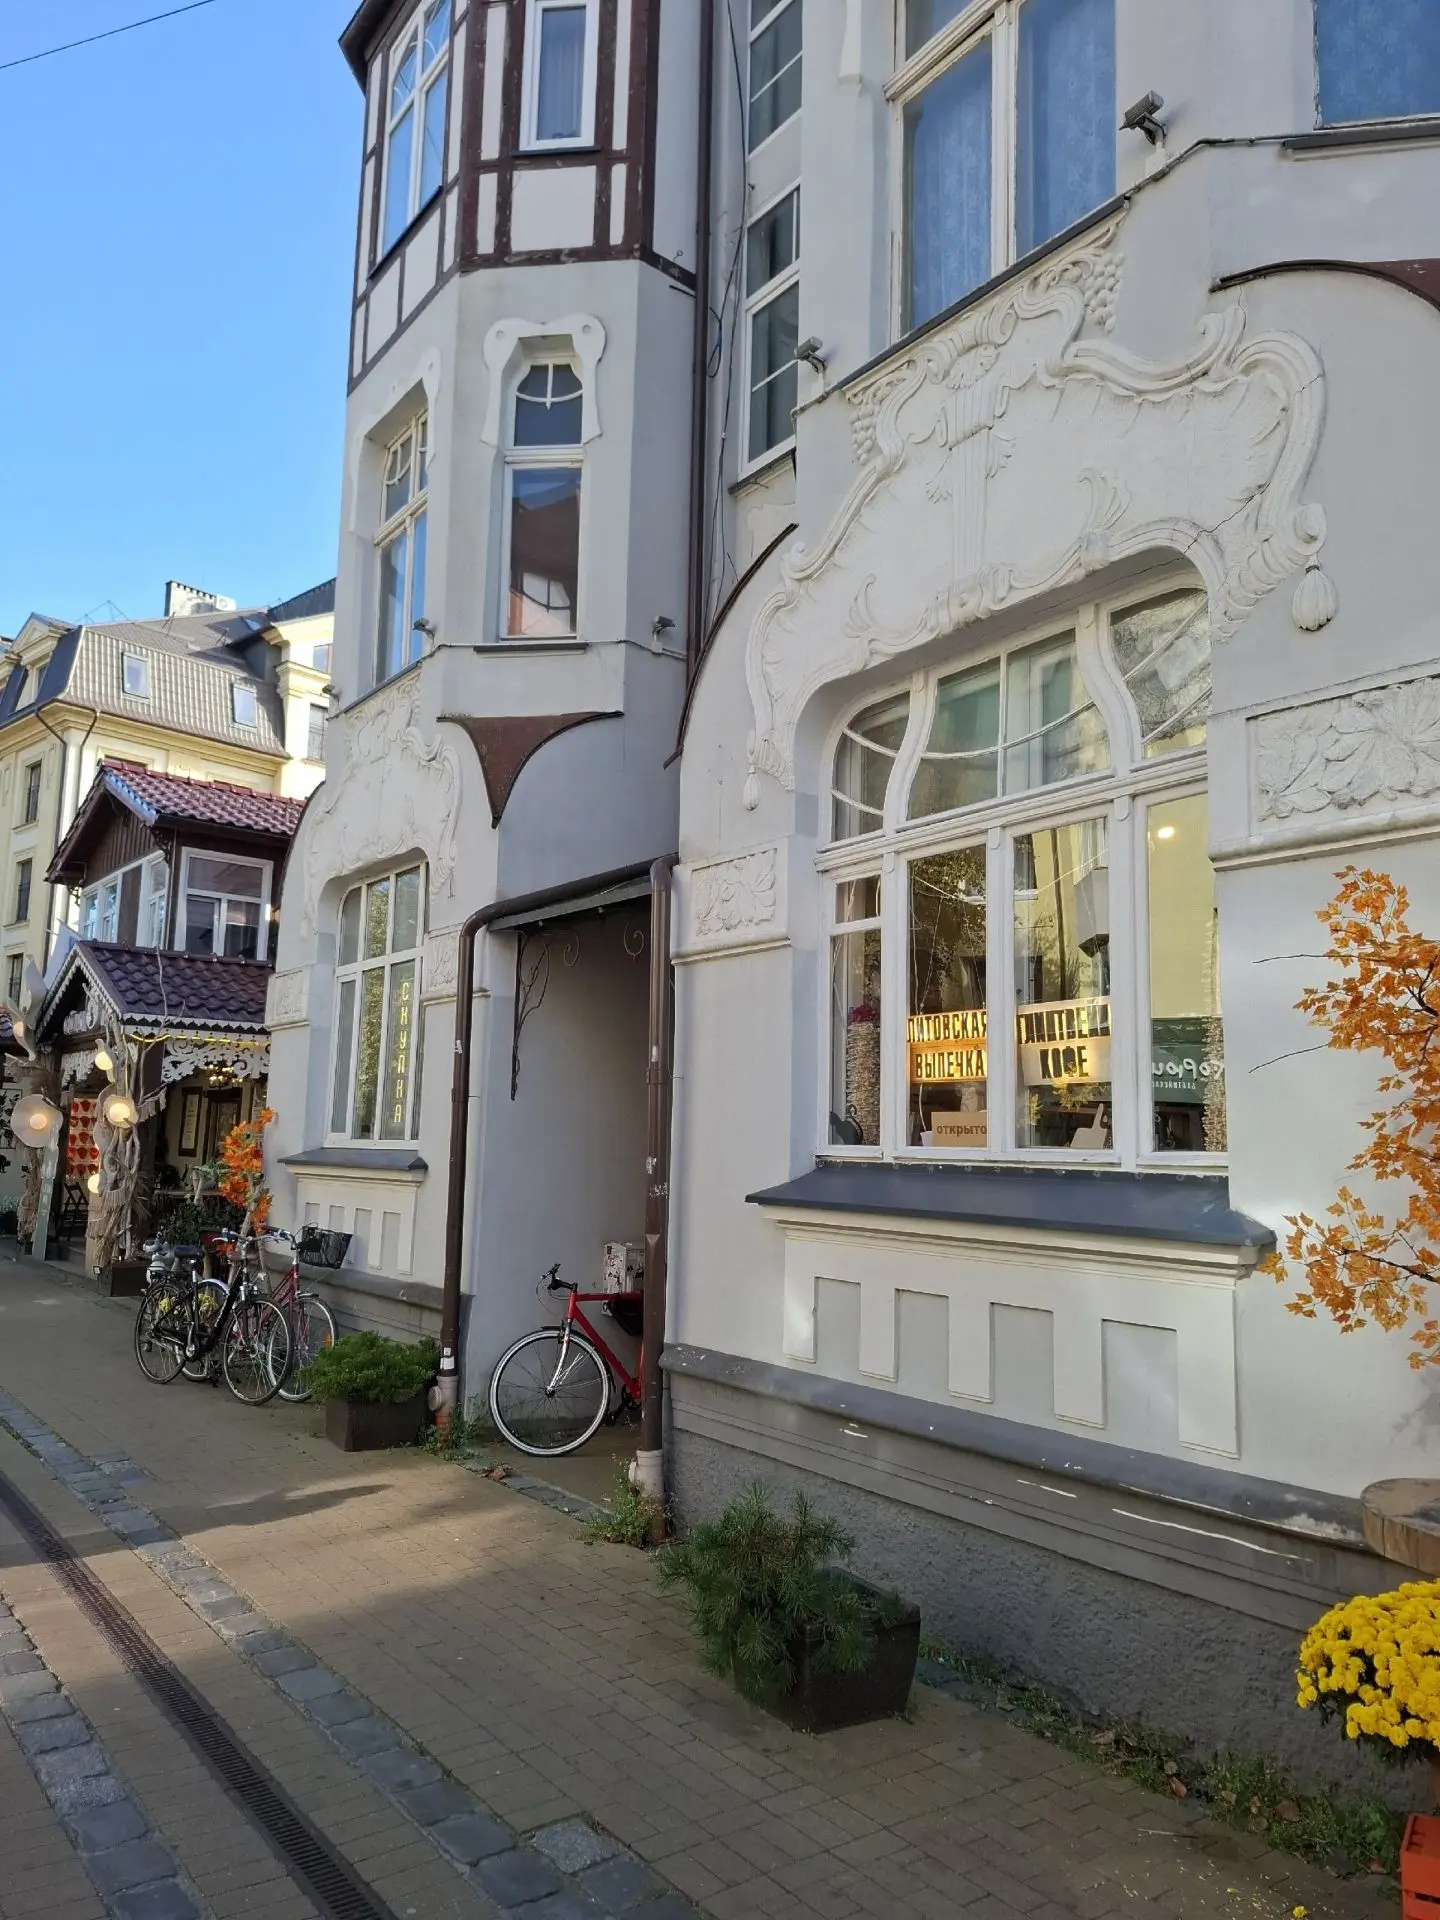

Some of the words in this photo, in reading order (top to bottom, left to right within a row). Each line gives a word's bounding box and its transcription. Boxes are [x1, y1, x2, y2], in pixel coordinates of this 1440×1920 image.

[907, 1010, 987, 1043] ЛИТОВСКАЯ
[394, 982, 410, 1124] СКУПКА
[915, 1049, 986, 1078] ВЫПЕЧКА
[1039, 1045, 1090, 1079] КОФЕ
[936, 1123, 987, 1138] открыто
